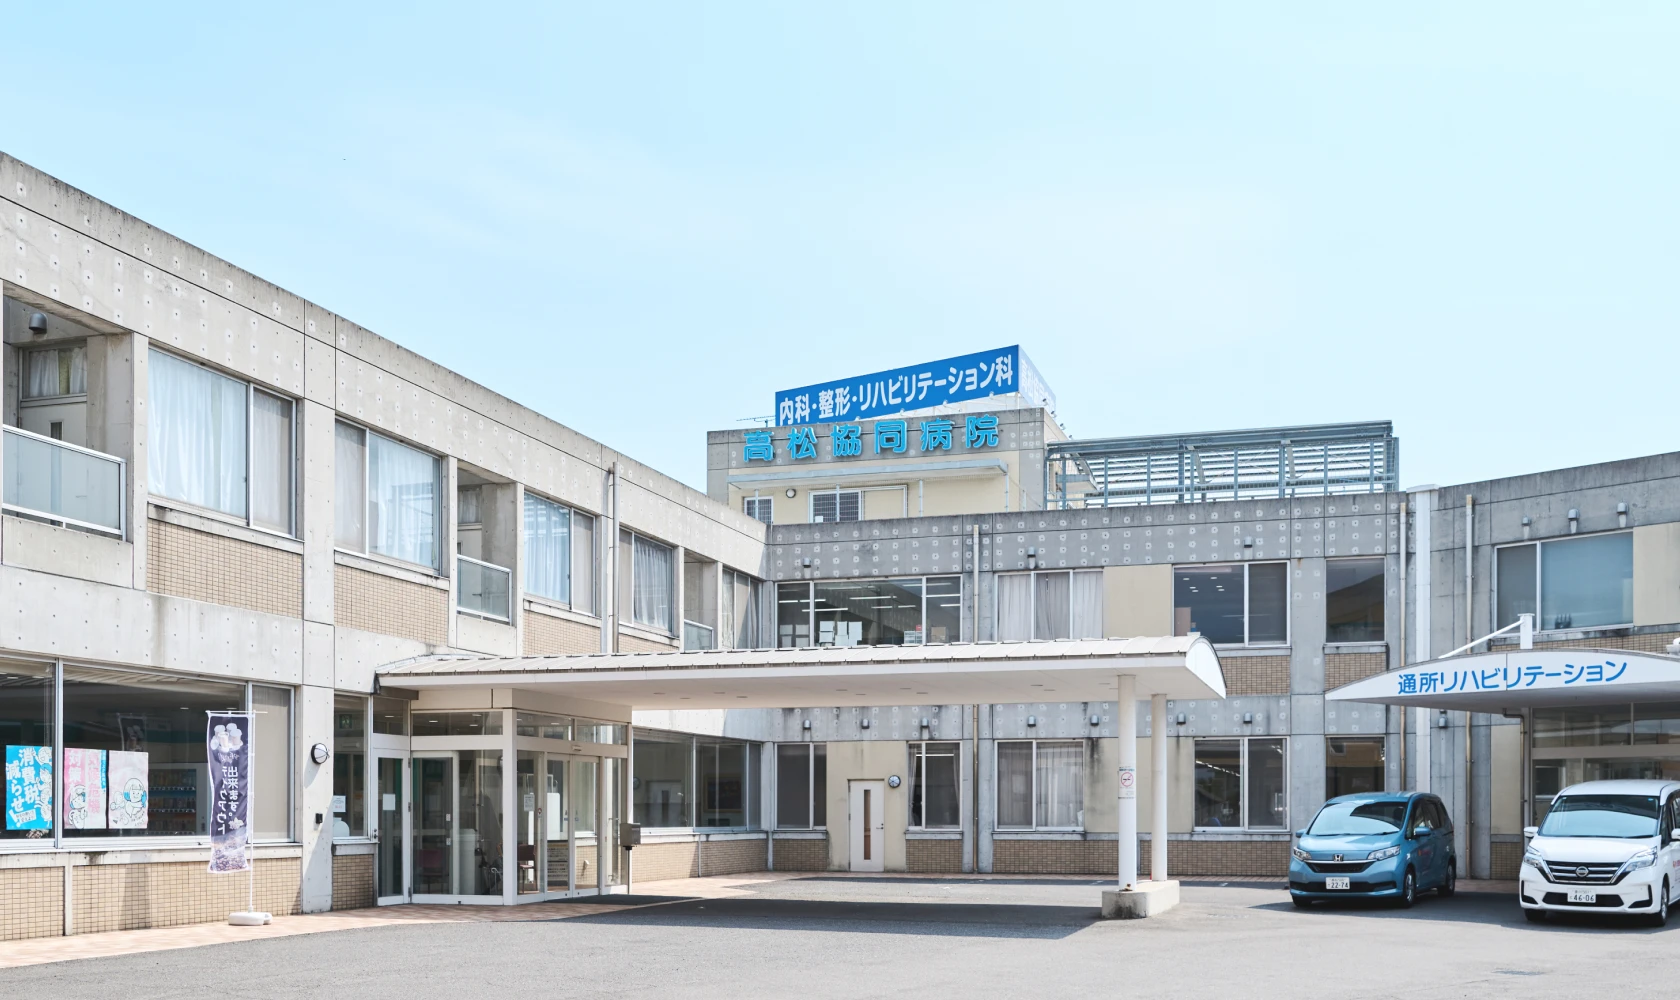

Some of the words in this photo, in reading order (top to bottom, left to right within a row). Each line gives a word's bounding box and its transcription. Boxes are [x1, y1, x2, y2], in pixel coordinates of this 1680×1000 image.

[779, 354, 1014, 425] 内科・整形・リハビリテーション科
[743, 415, 1000, 462] 高松協同病院
[1397, 660, 1628, 695] 通所リハビリテーション
[18, 747, 40, 804] 消費税
